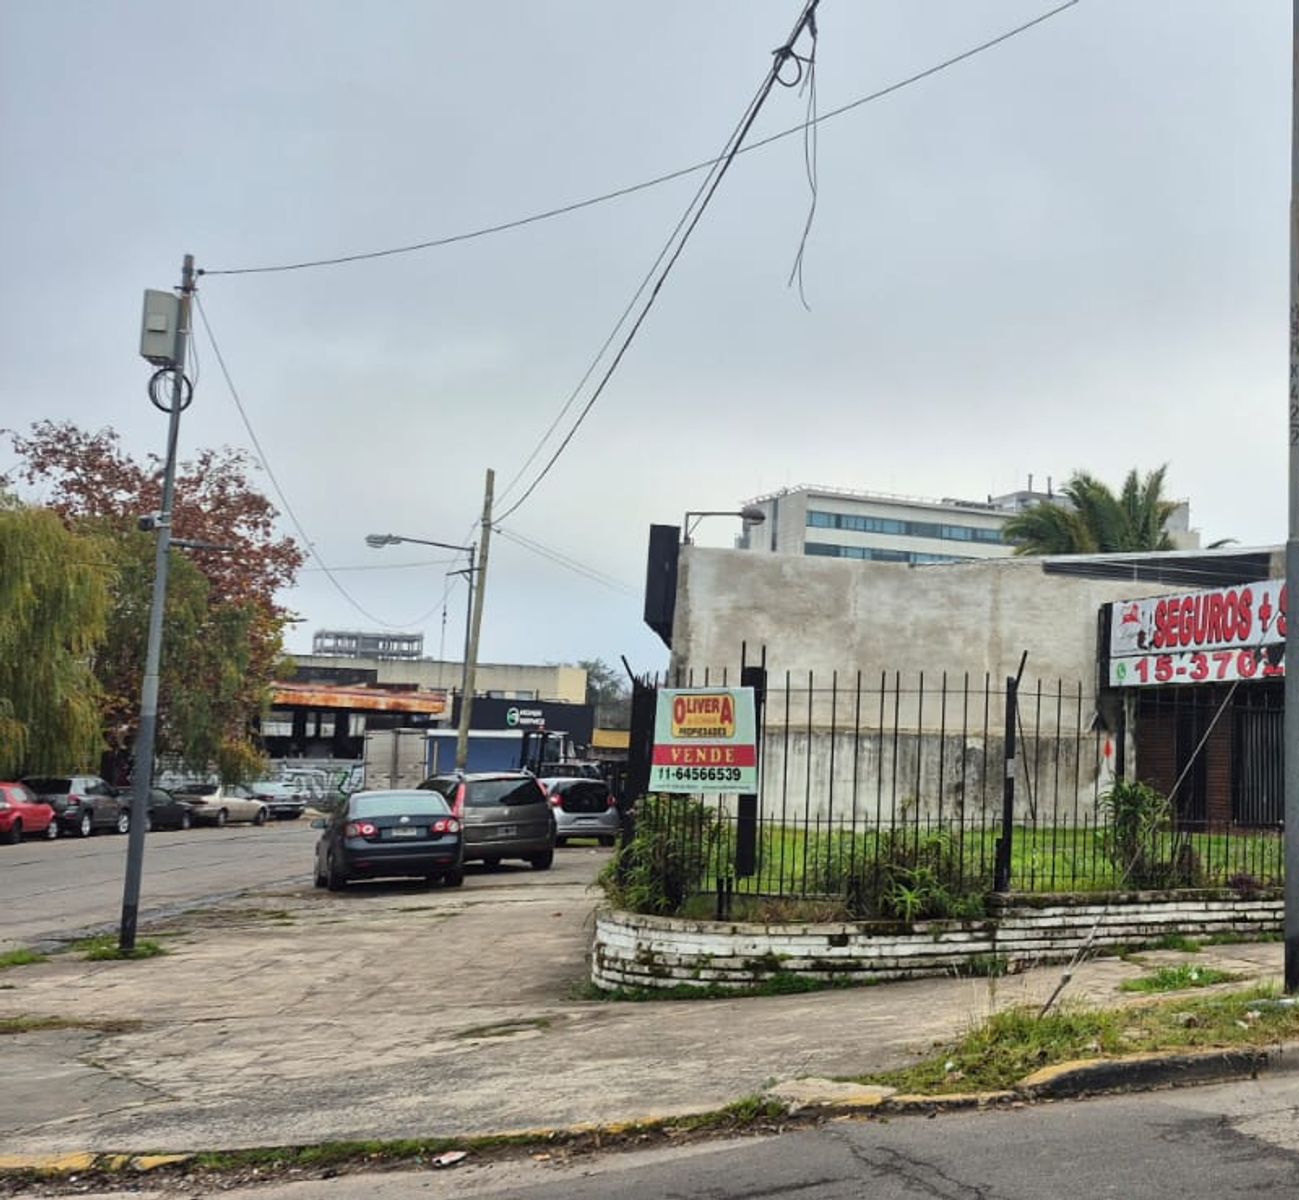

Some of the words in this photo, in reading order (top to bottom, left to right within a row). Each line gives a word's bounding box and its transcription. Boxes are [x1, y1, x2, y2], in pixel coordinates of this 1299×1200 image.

[1154, 588, 1252, 648] SEGUROS
[673, 697, 733, 725] OLIVERA
[671, 748, 735, 763] VENDE
[658, 767, 742, 781] 11-64566539
